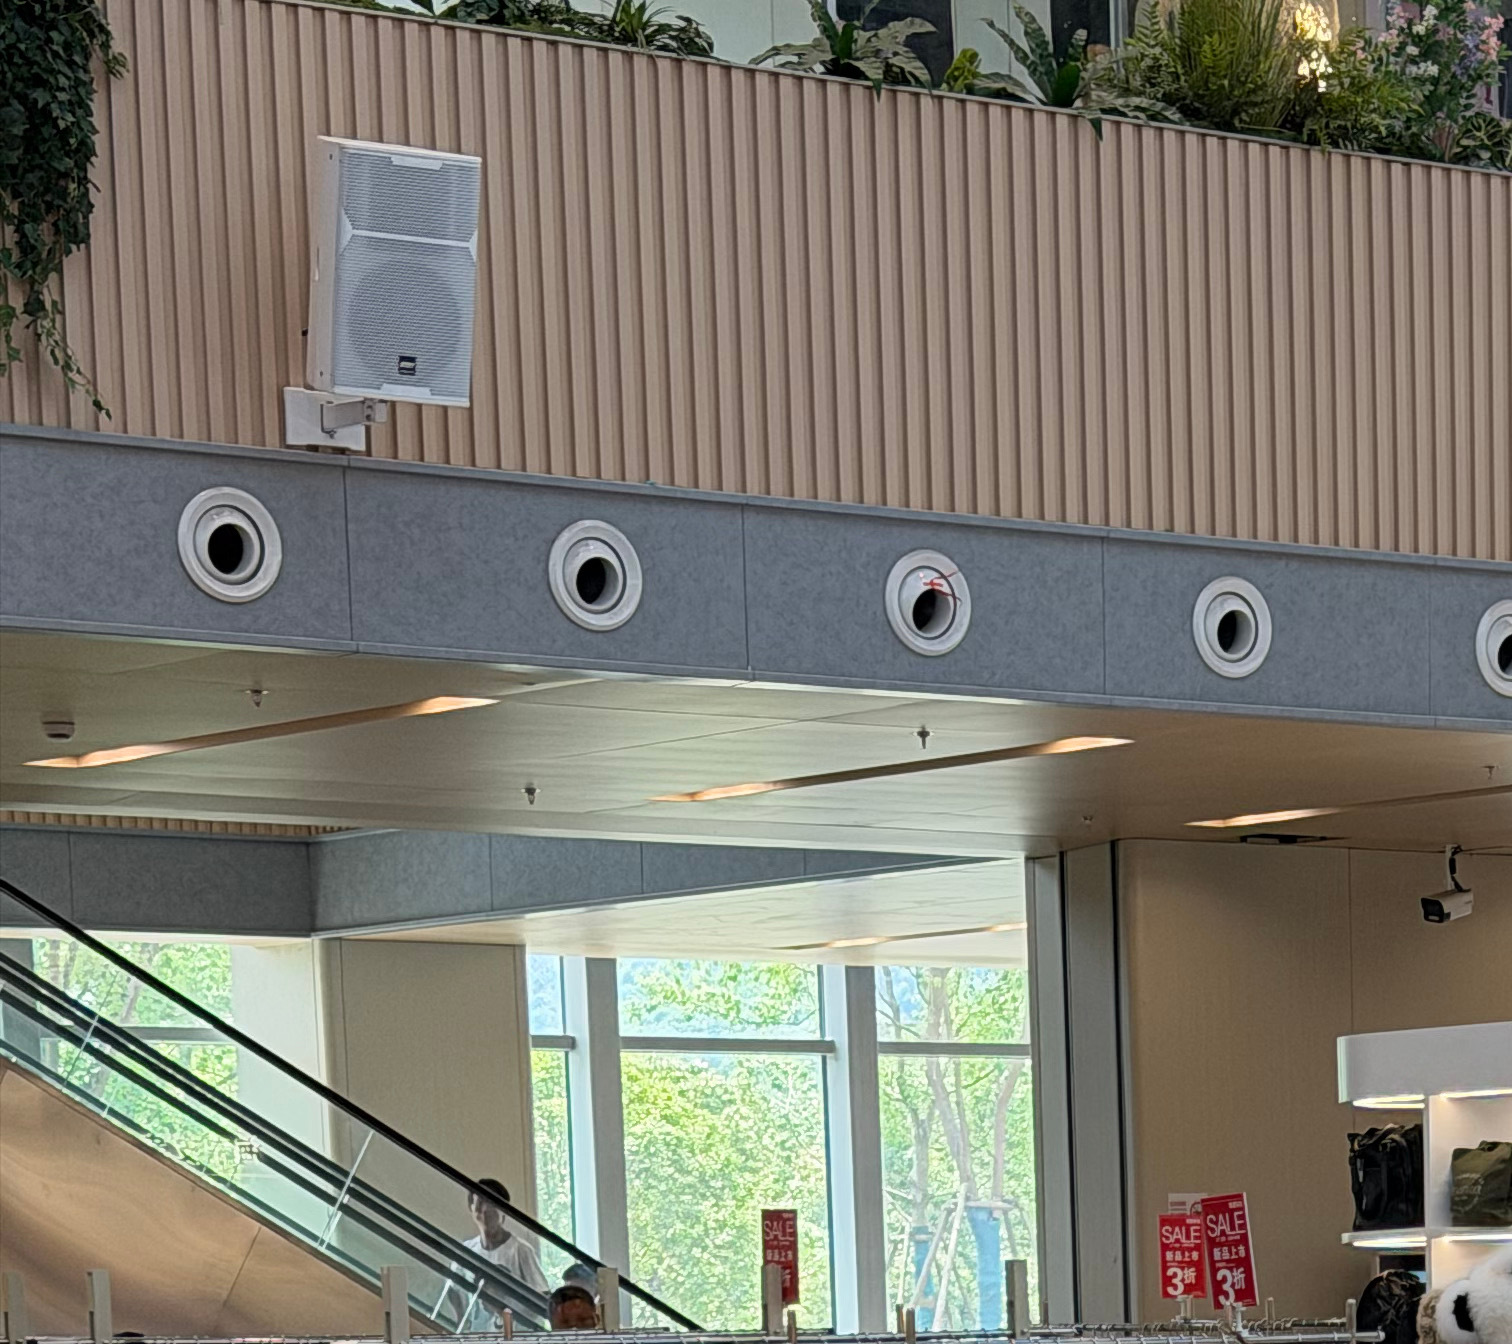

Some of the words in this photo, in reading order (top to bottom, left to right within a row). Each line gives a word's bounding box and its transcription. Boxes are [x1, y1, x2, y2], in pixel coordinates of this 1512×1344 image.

[763, 1221, 795, 1240] SALE
[1206, 1211, 1247, 1238] SALE
[1162, 1225, 1201, 1244] SALE
[1165, 1250, 1199, 1262] 新品上市
[1213, 1244, 1246, 1261] 新品上市
[1166, 1267, 1197, 1296] 3折
[1216, 1267, 1246, 1306] 3折
